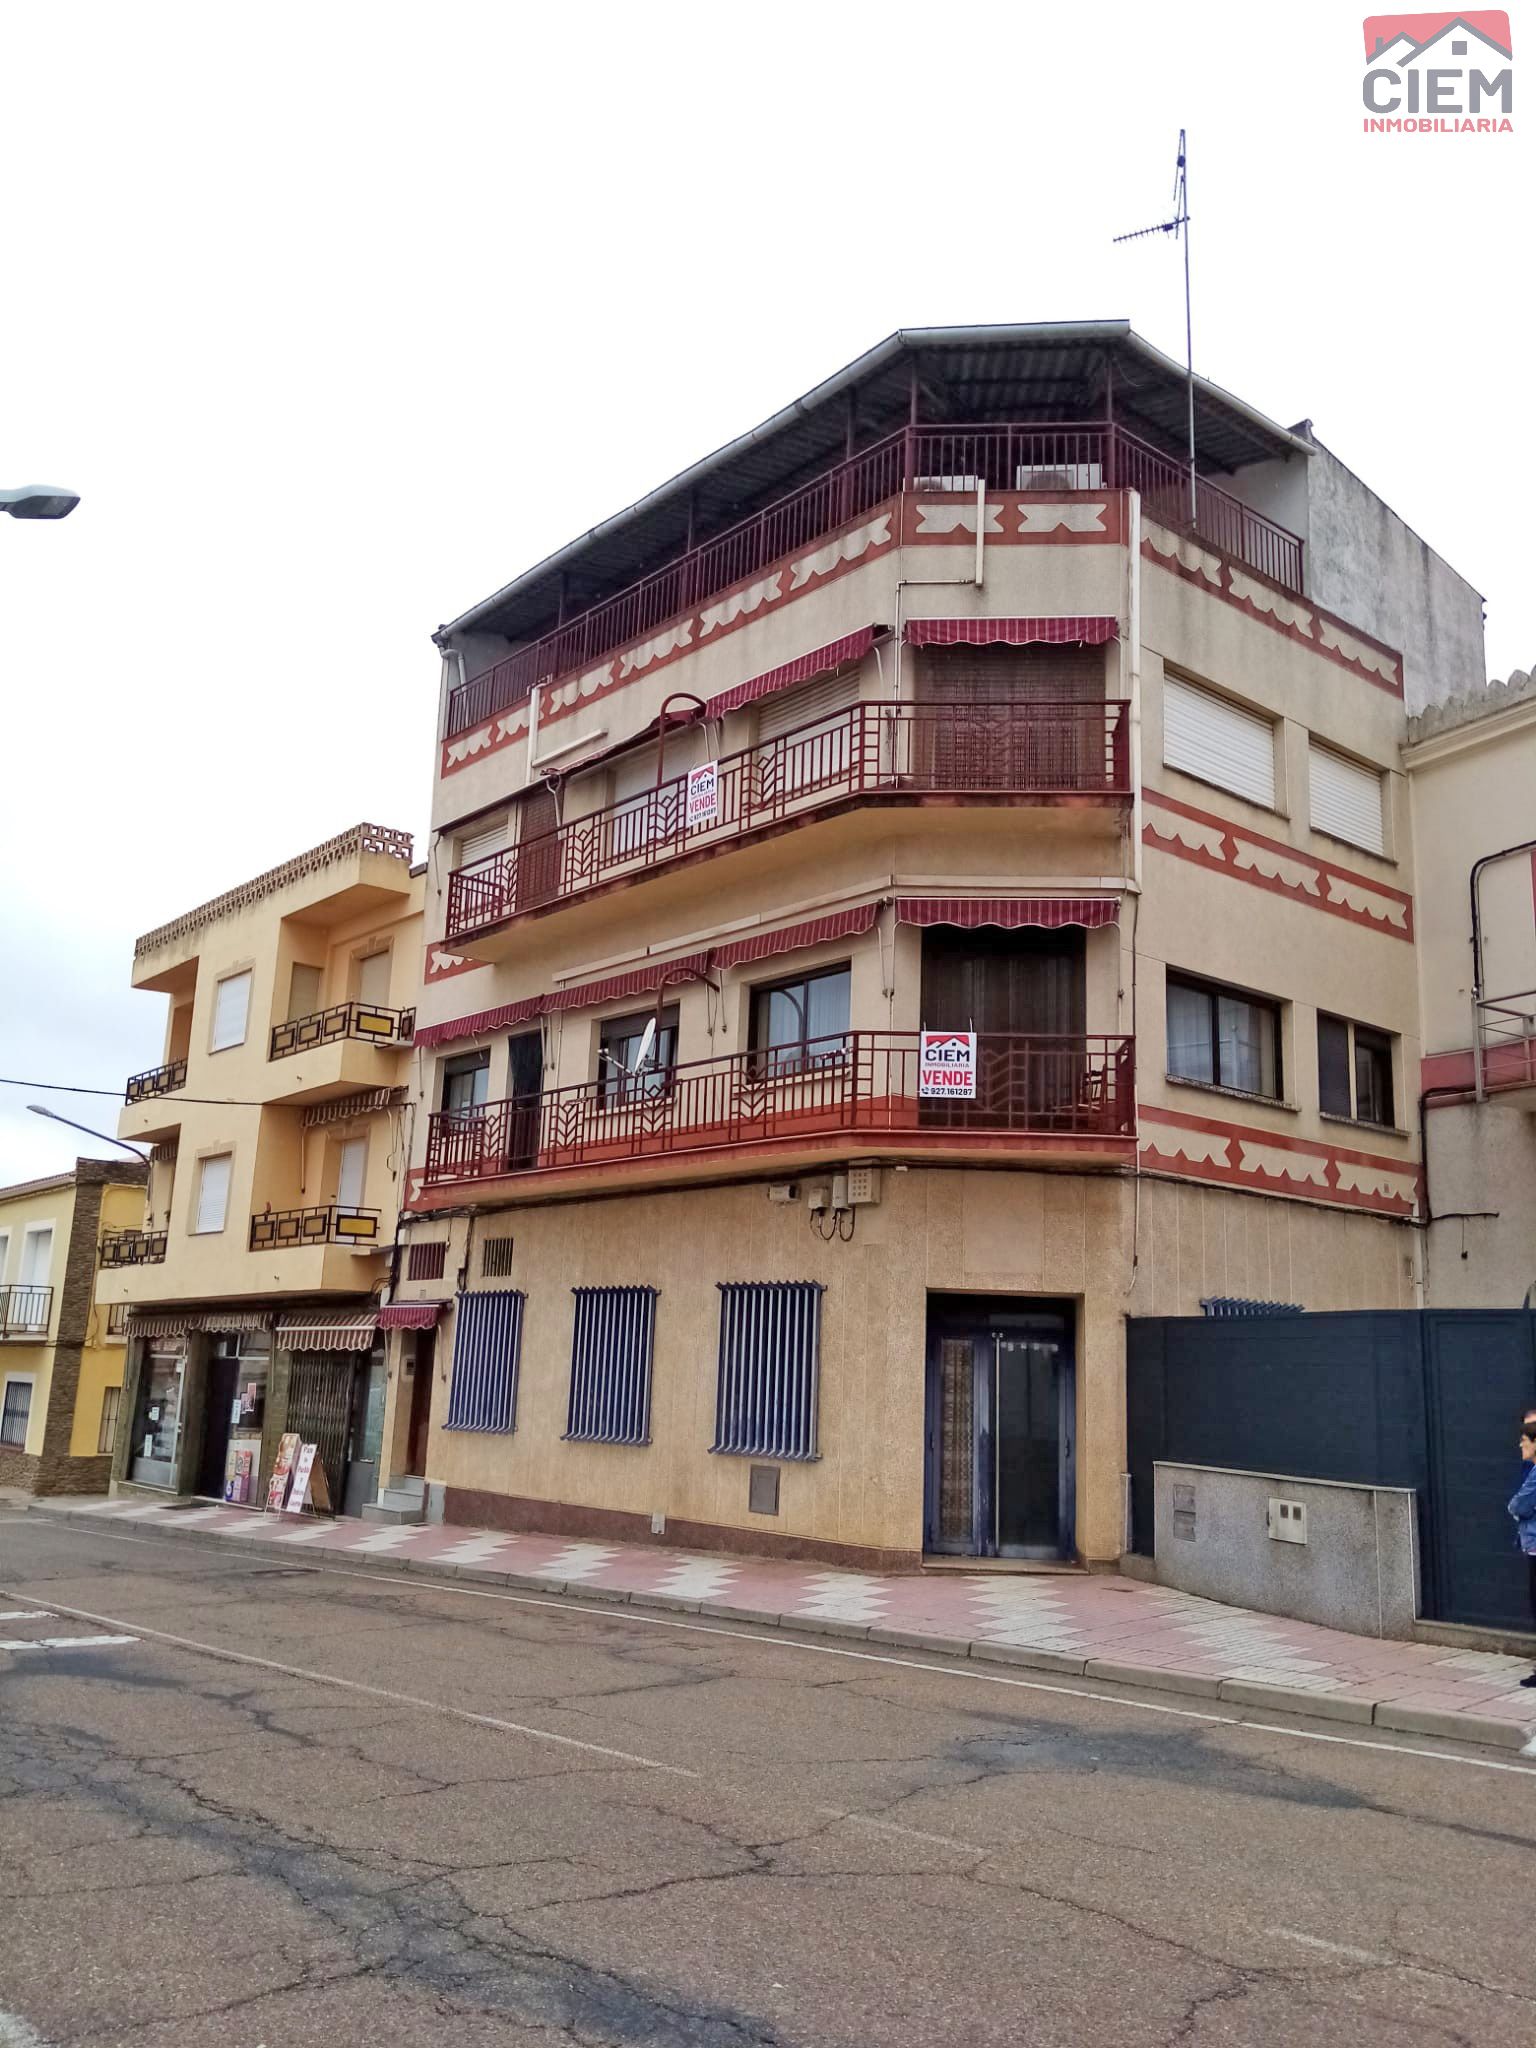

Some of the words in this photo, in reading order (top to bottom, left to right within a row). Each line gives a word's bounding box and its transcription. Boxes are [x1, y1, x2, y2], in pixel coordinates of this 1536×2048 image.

[690, 777, 715, 796] CIEM
[689, 792, 717, 814] VENDE
[925, 1048, 970, 1062] CIEM
[922, 1069, 973, 1087] VENDE
[930, 1087, 973, 1096] 927.161287
